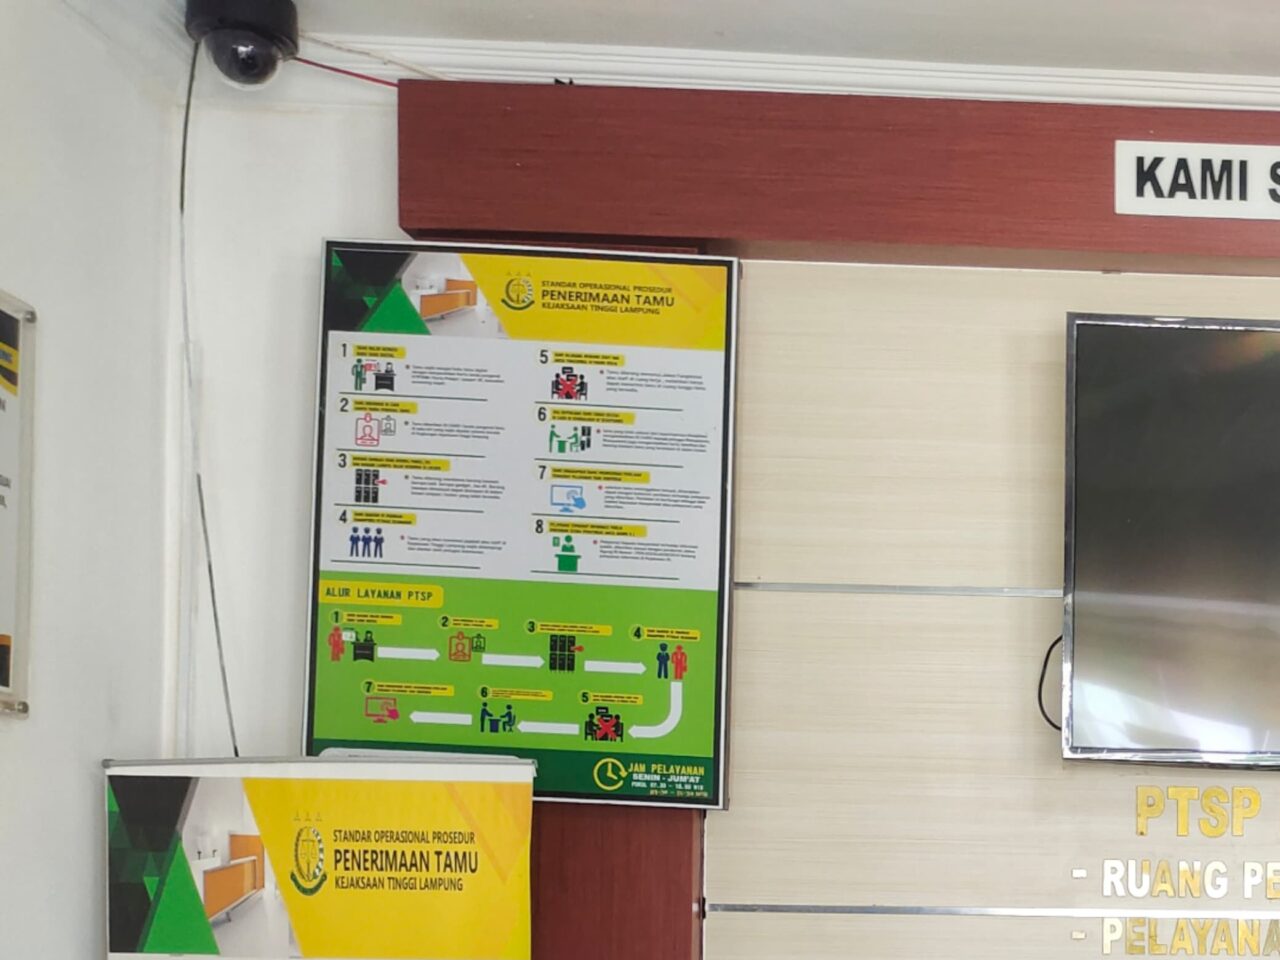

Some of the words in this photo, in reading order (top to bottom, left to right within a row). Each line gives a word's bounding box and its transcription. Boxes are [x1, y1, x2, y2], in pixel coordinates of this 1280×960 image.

[1134, 156, 1249, 201] KAMI
[541, 281, 577, 289] STANDAR
[578, 282, 631, 292] OPERASIONAL
[633, 285, 673, 294] PROSEDUR
[541, 290, 631, 305] PENERIMAAN
[635, 294, 675, 307] TAMU
[541, 302, 588, 312] KEJAKSAAN
[590, 304, 618, 314] TINGGI
[620, 306, 661, 316] LAMPUNG
[341, 343, 347, 358] 1
[539, 349, 549, 364] 5
[339, 397, 349, 413] 2
[537, 406, 547, 422] 6
[337, 453, 347, 469] 3
[538, 465, 547, 480] 7
[338, 509, 348, 524] 4
[535, 519, 544, 534] 8
[325, 587, 351, 598] ALUR
[357, 588, 401, 600] LAYANAN
[407, 590, 433, 601] PTSP
[333, 610, 340, 623] 1
[441, 616, 449, 628] 2
[527, 620, 536, 633] 3
[633, 626, 642, 640] 4
[364, 681, 373, 693] 7
[480, 686, 489, 698] 6
[581, 691, 589, 704] 5
[632, 773, 661, 781] SENIN
[651, 763, 705, 776] PELAYANAN
[1135, 785, 1262, 838] PTSP
[333, 829, 372, 843] STANDAR
[374, 830, 430, 844] OPERASIONAL
[432, 831, 476, 845] PROSEDUR
[334, 849, 430, 873] PENERIMAAN
[433, 850, 479, 873] TAMU
[335, 876, 385, 891] KEJAKSAAN
[387, 877, 418, 891] TINGGI
[419, 877, 463, 892] LAMPUNG
[1102, 859, 1229, 900] RUANG
